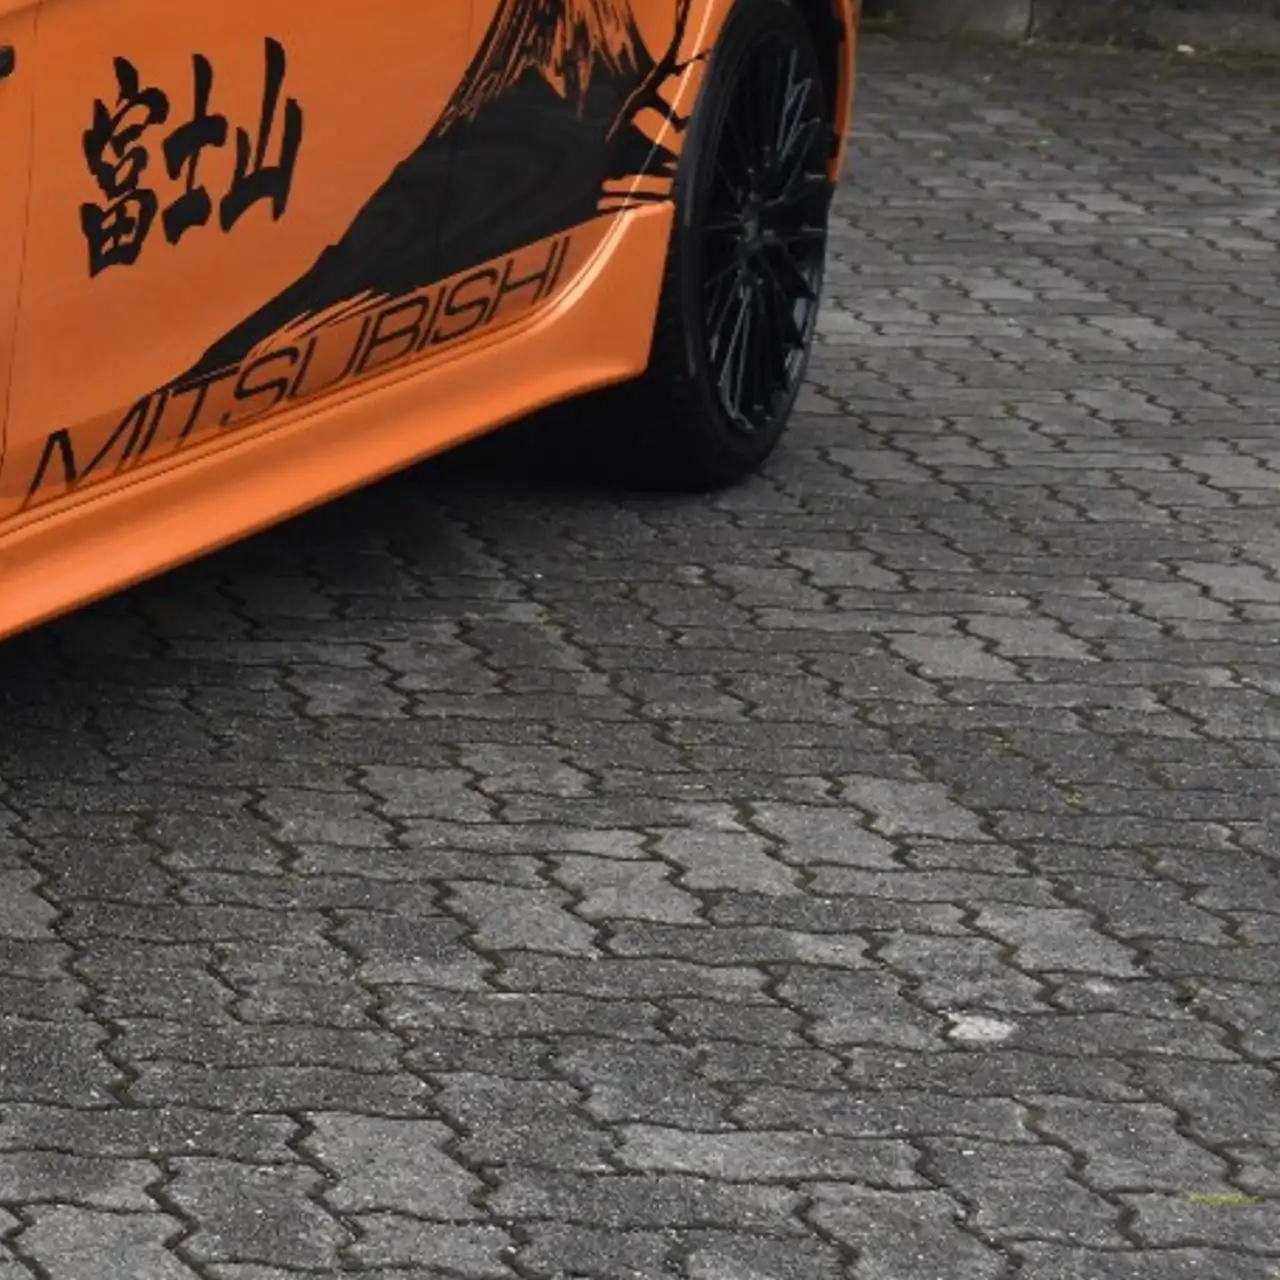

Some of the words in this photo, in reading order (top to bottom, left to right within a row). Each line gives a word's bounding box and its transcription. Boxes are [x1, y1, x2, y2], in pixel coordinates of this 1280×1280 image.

[80, 36, 303, 278] 富士山
[22, 237, 570, 510] MITSUBISHI
